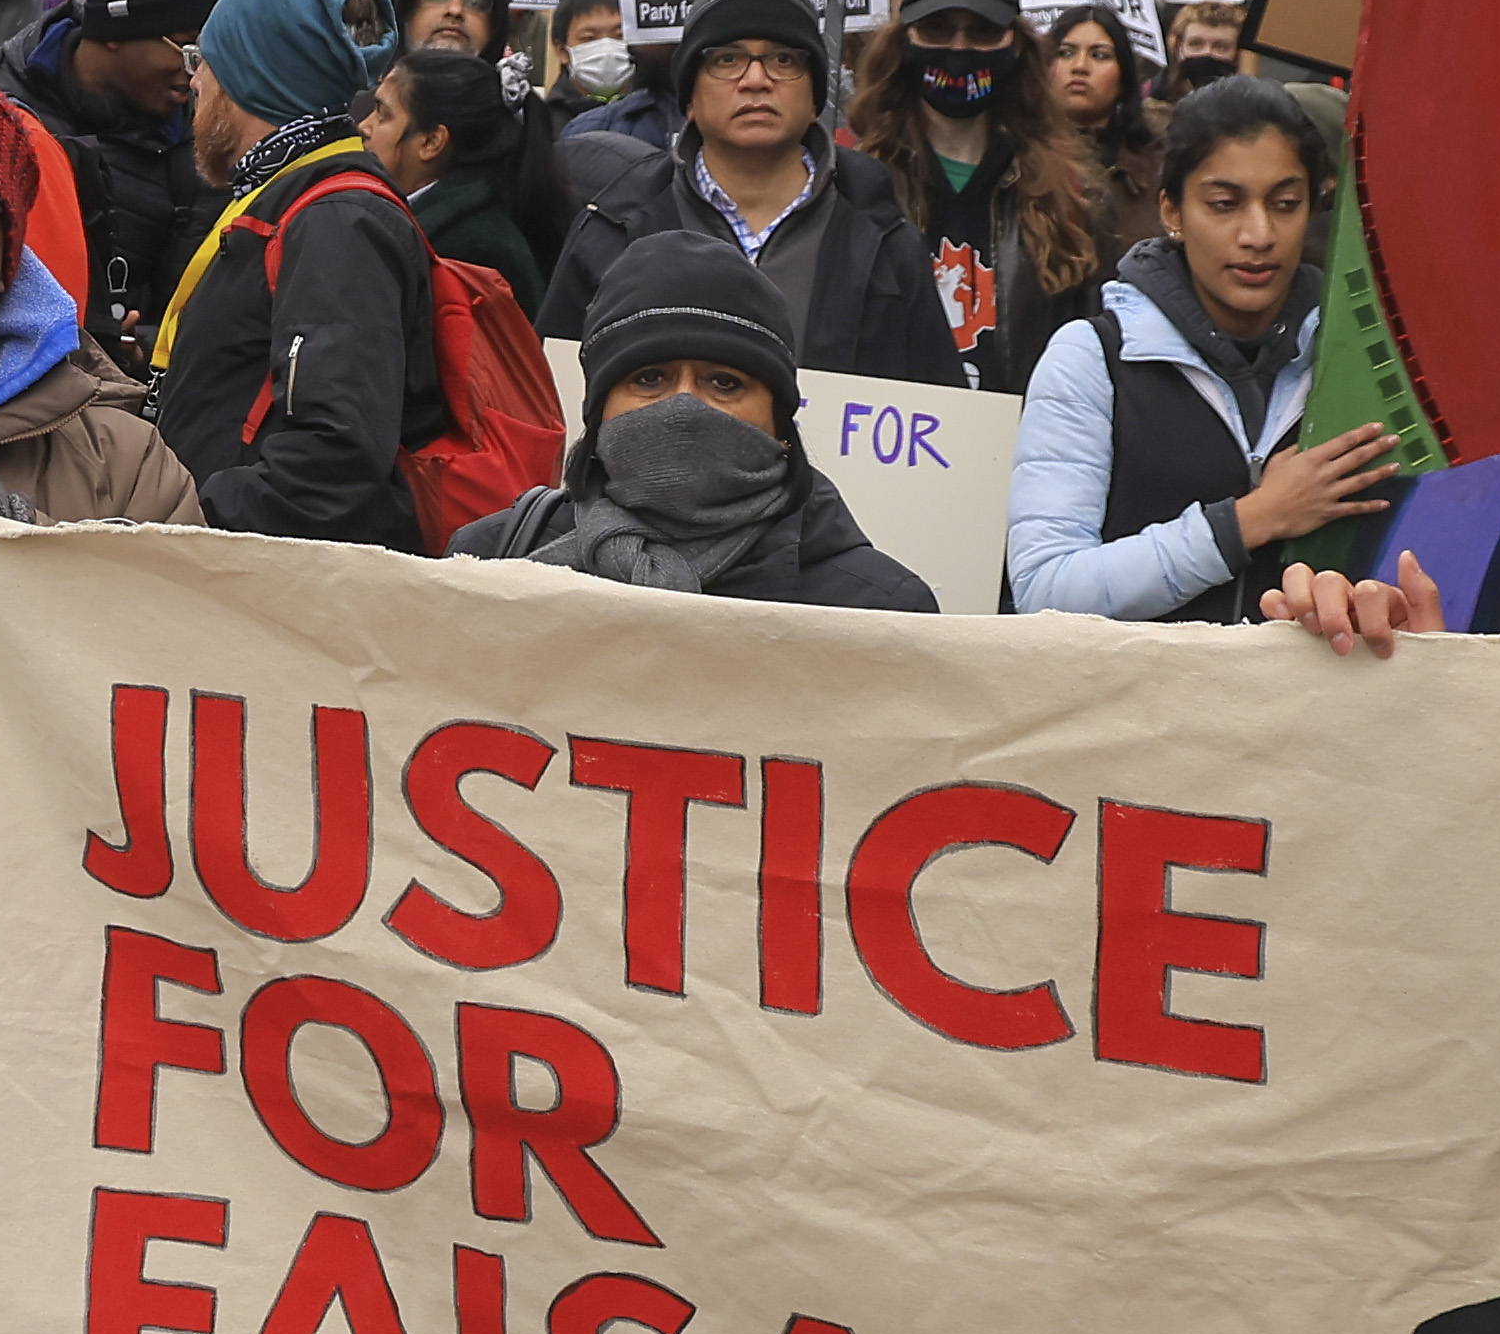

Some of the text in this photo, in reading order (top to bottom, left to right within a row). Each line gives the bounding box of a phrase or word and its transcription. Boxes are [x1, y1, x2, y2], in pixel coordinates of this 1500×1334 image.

[840, 402, 950, 468] FOR
[83, 683, 1271, 1085] JUSTICE
[92, 923, 666, 1249] FOR
